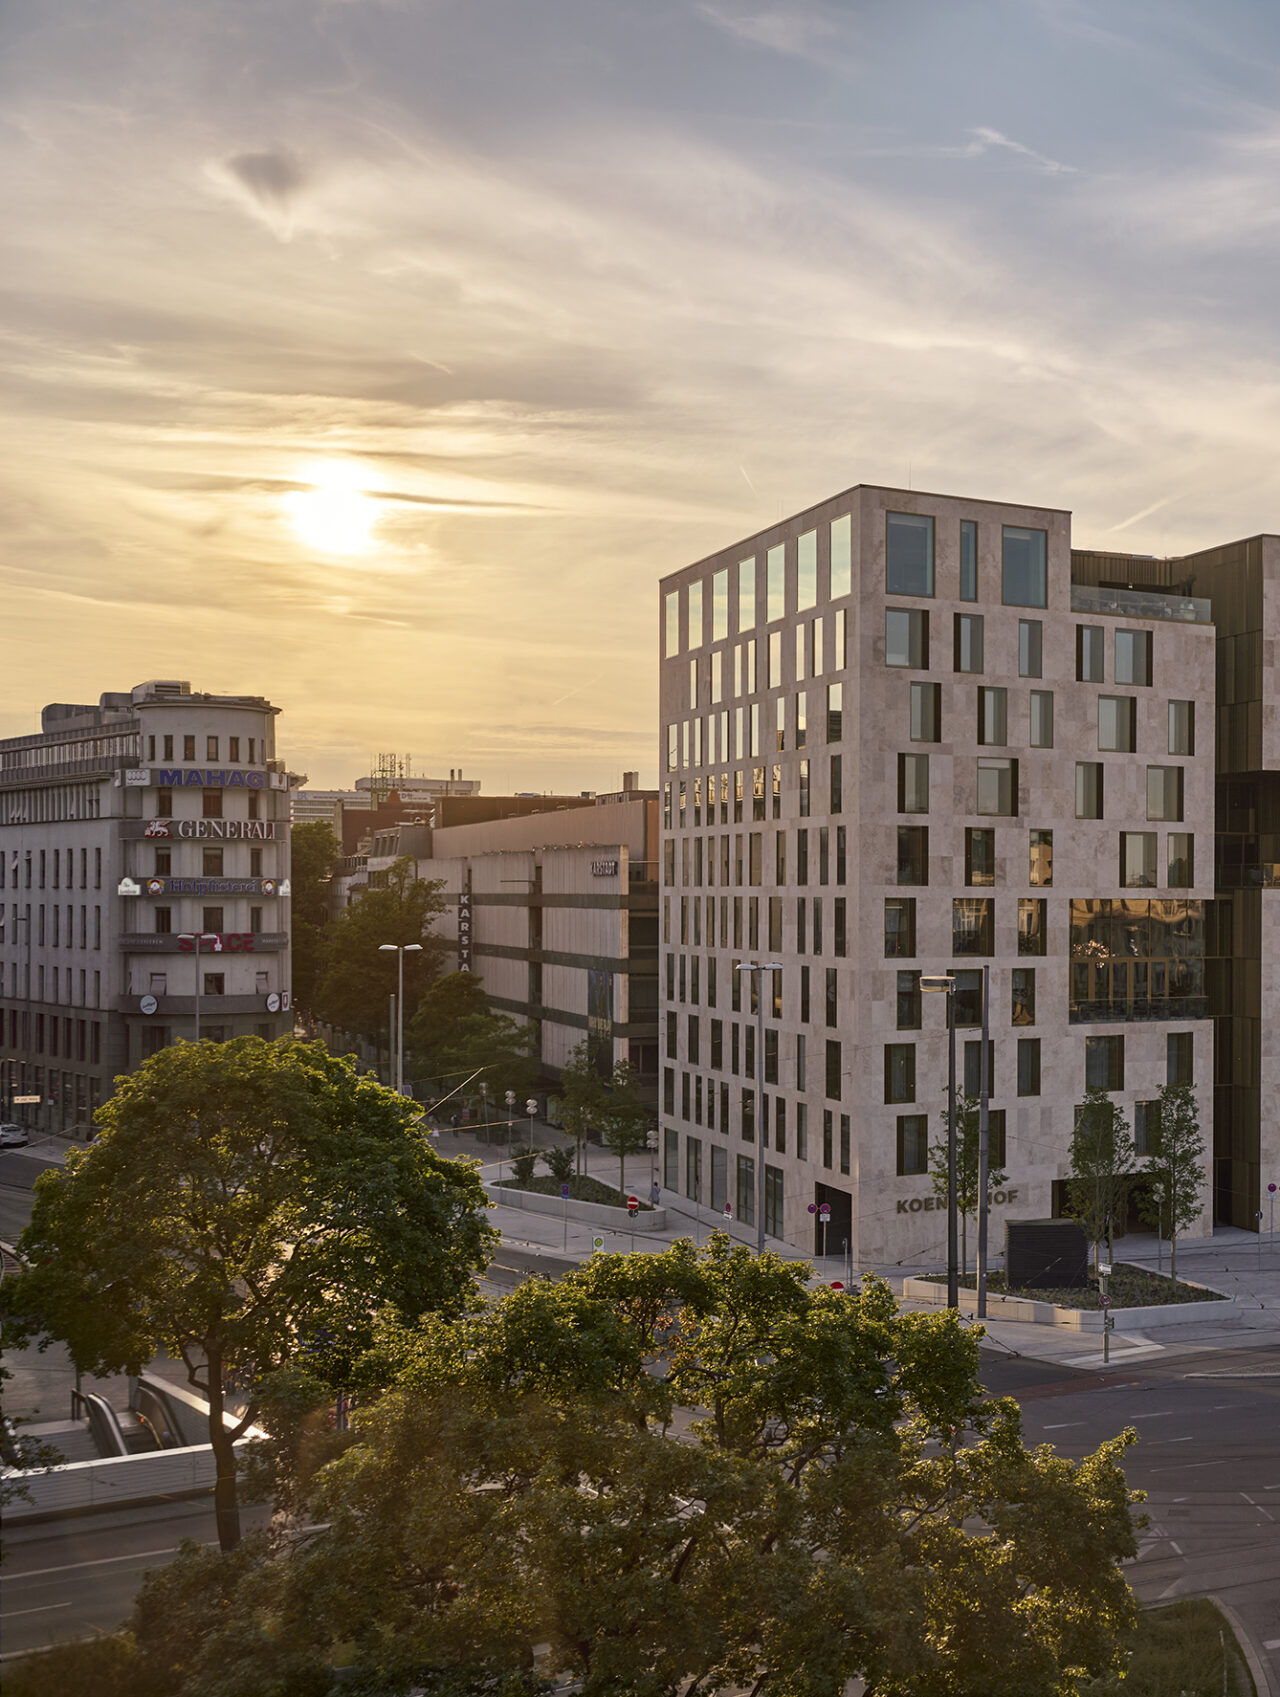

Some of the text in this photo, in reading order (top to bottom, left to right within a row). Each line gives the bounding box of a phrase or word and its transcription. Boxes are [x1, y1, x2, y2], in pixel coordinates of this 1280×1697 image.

[159, 769, 265, 787] MAHAG
[178, 821, 276, 840] GENERALI
[171, 880, 257, 896] Hofpfisterei
[178, 933, 255, 951] SPACE
[897, 1190, 1019, 1214] KOENOF
